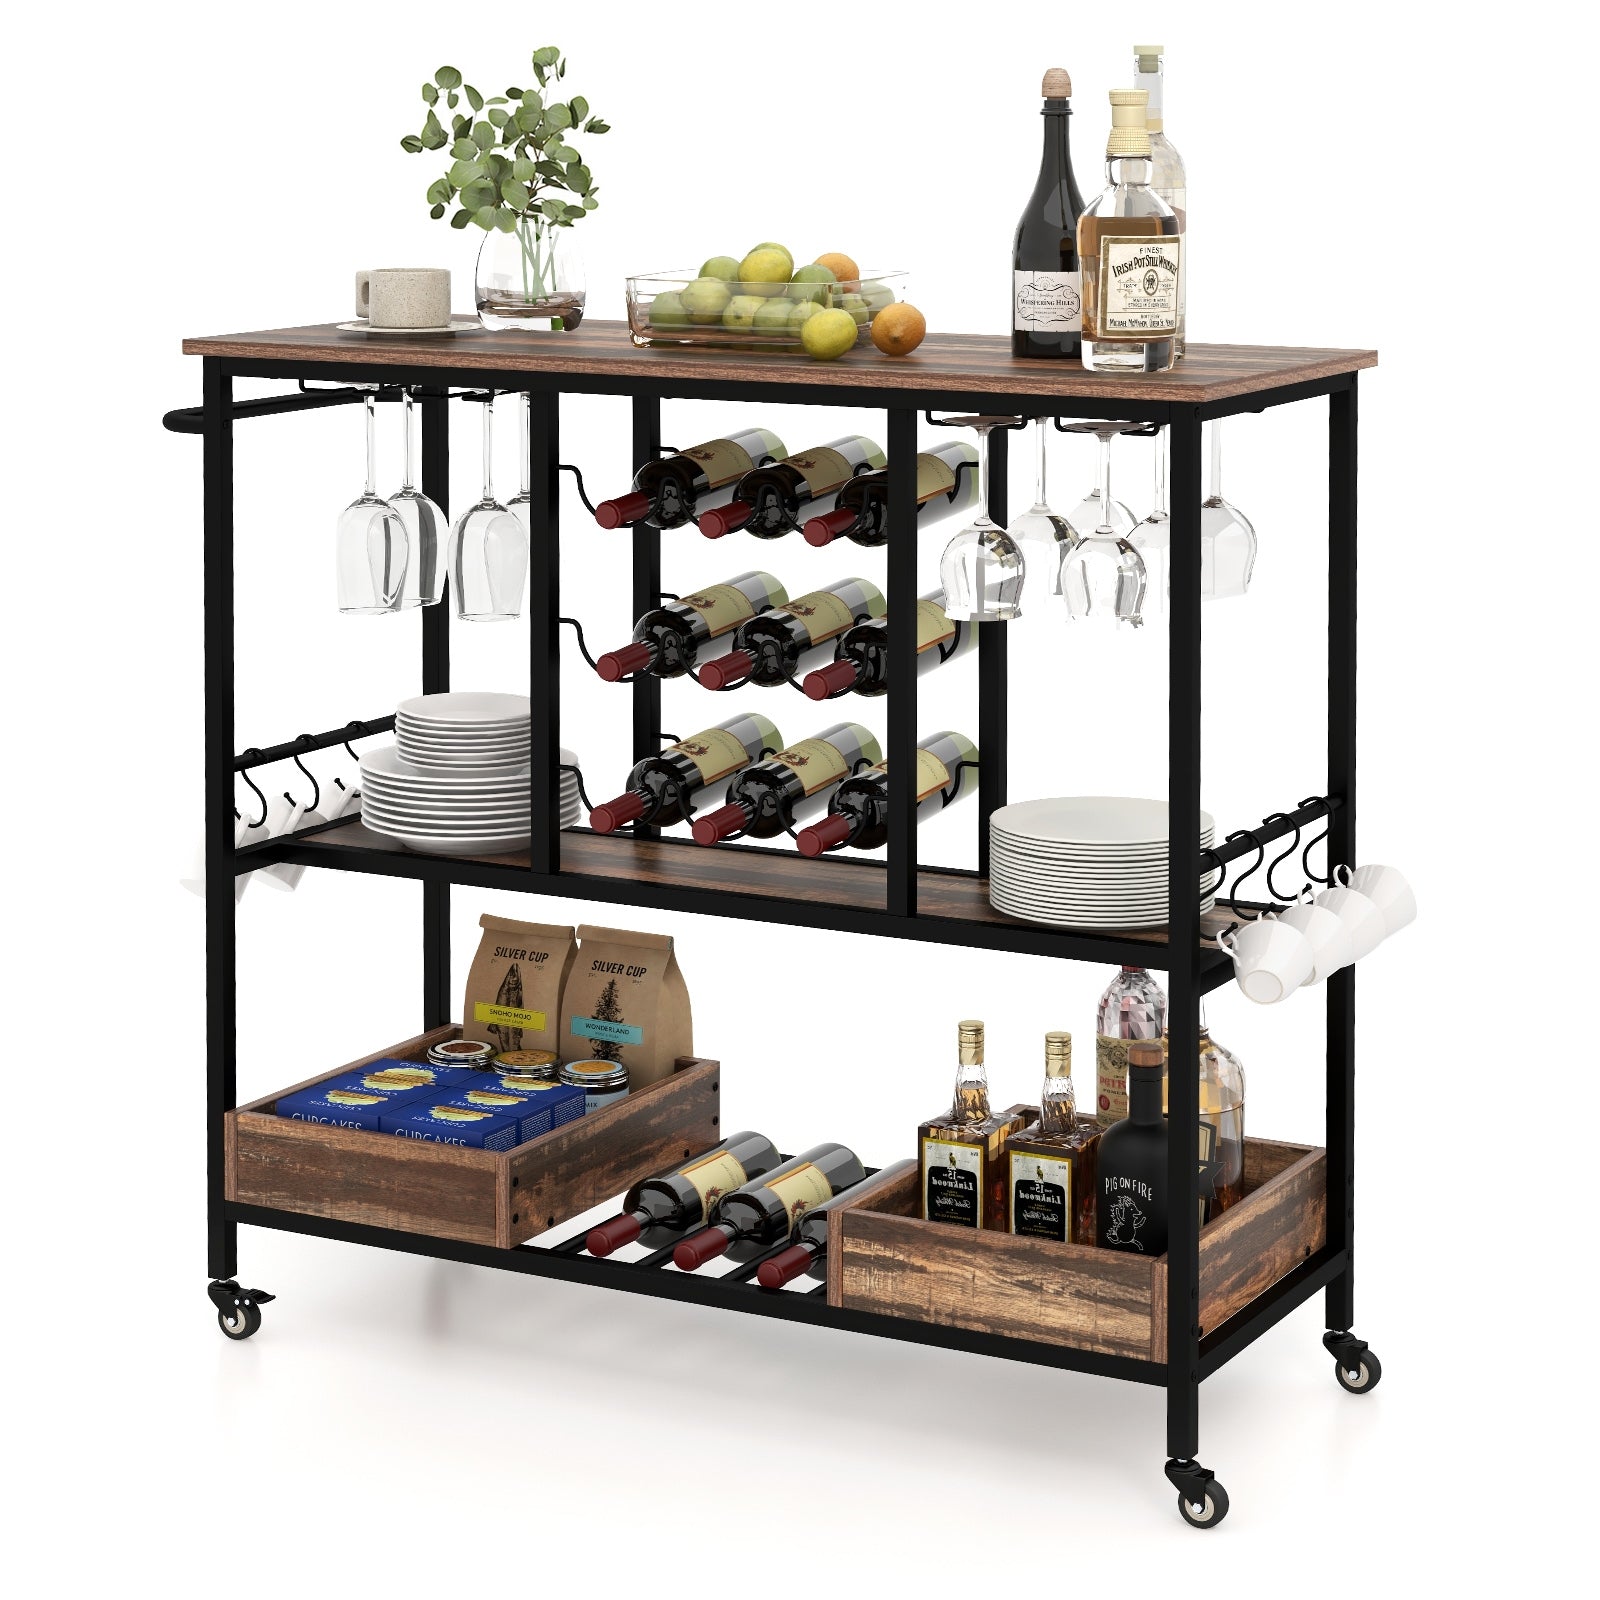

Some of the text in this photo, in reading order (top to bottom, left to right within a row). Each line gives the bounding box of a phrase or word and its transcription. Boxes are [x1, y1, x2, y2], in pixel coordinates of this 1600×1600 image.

[1112, 261, 1133, 277] IRISH
[1134, 257, 1146, 269] POT
[1146, 255, 1159, 267] STILL
[494, 946, 527, 961] SILVER
[528, 950, 549, 963] CUP
[591, 959, 625, 975] SILVER
[625, 965, 647, 978] CUP
[513, 1013, 532, 1021] MOJO
[585, 1023, 630, 1035] WONDERLAND
[1105, 1176, 1153, 1201] PIG ON FIRE
